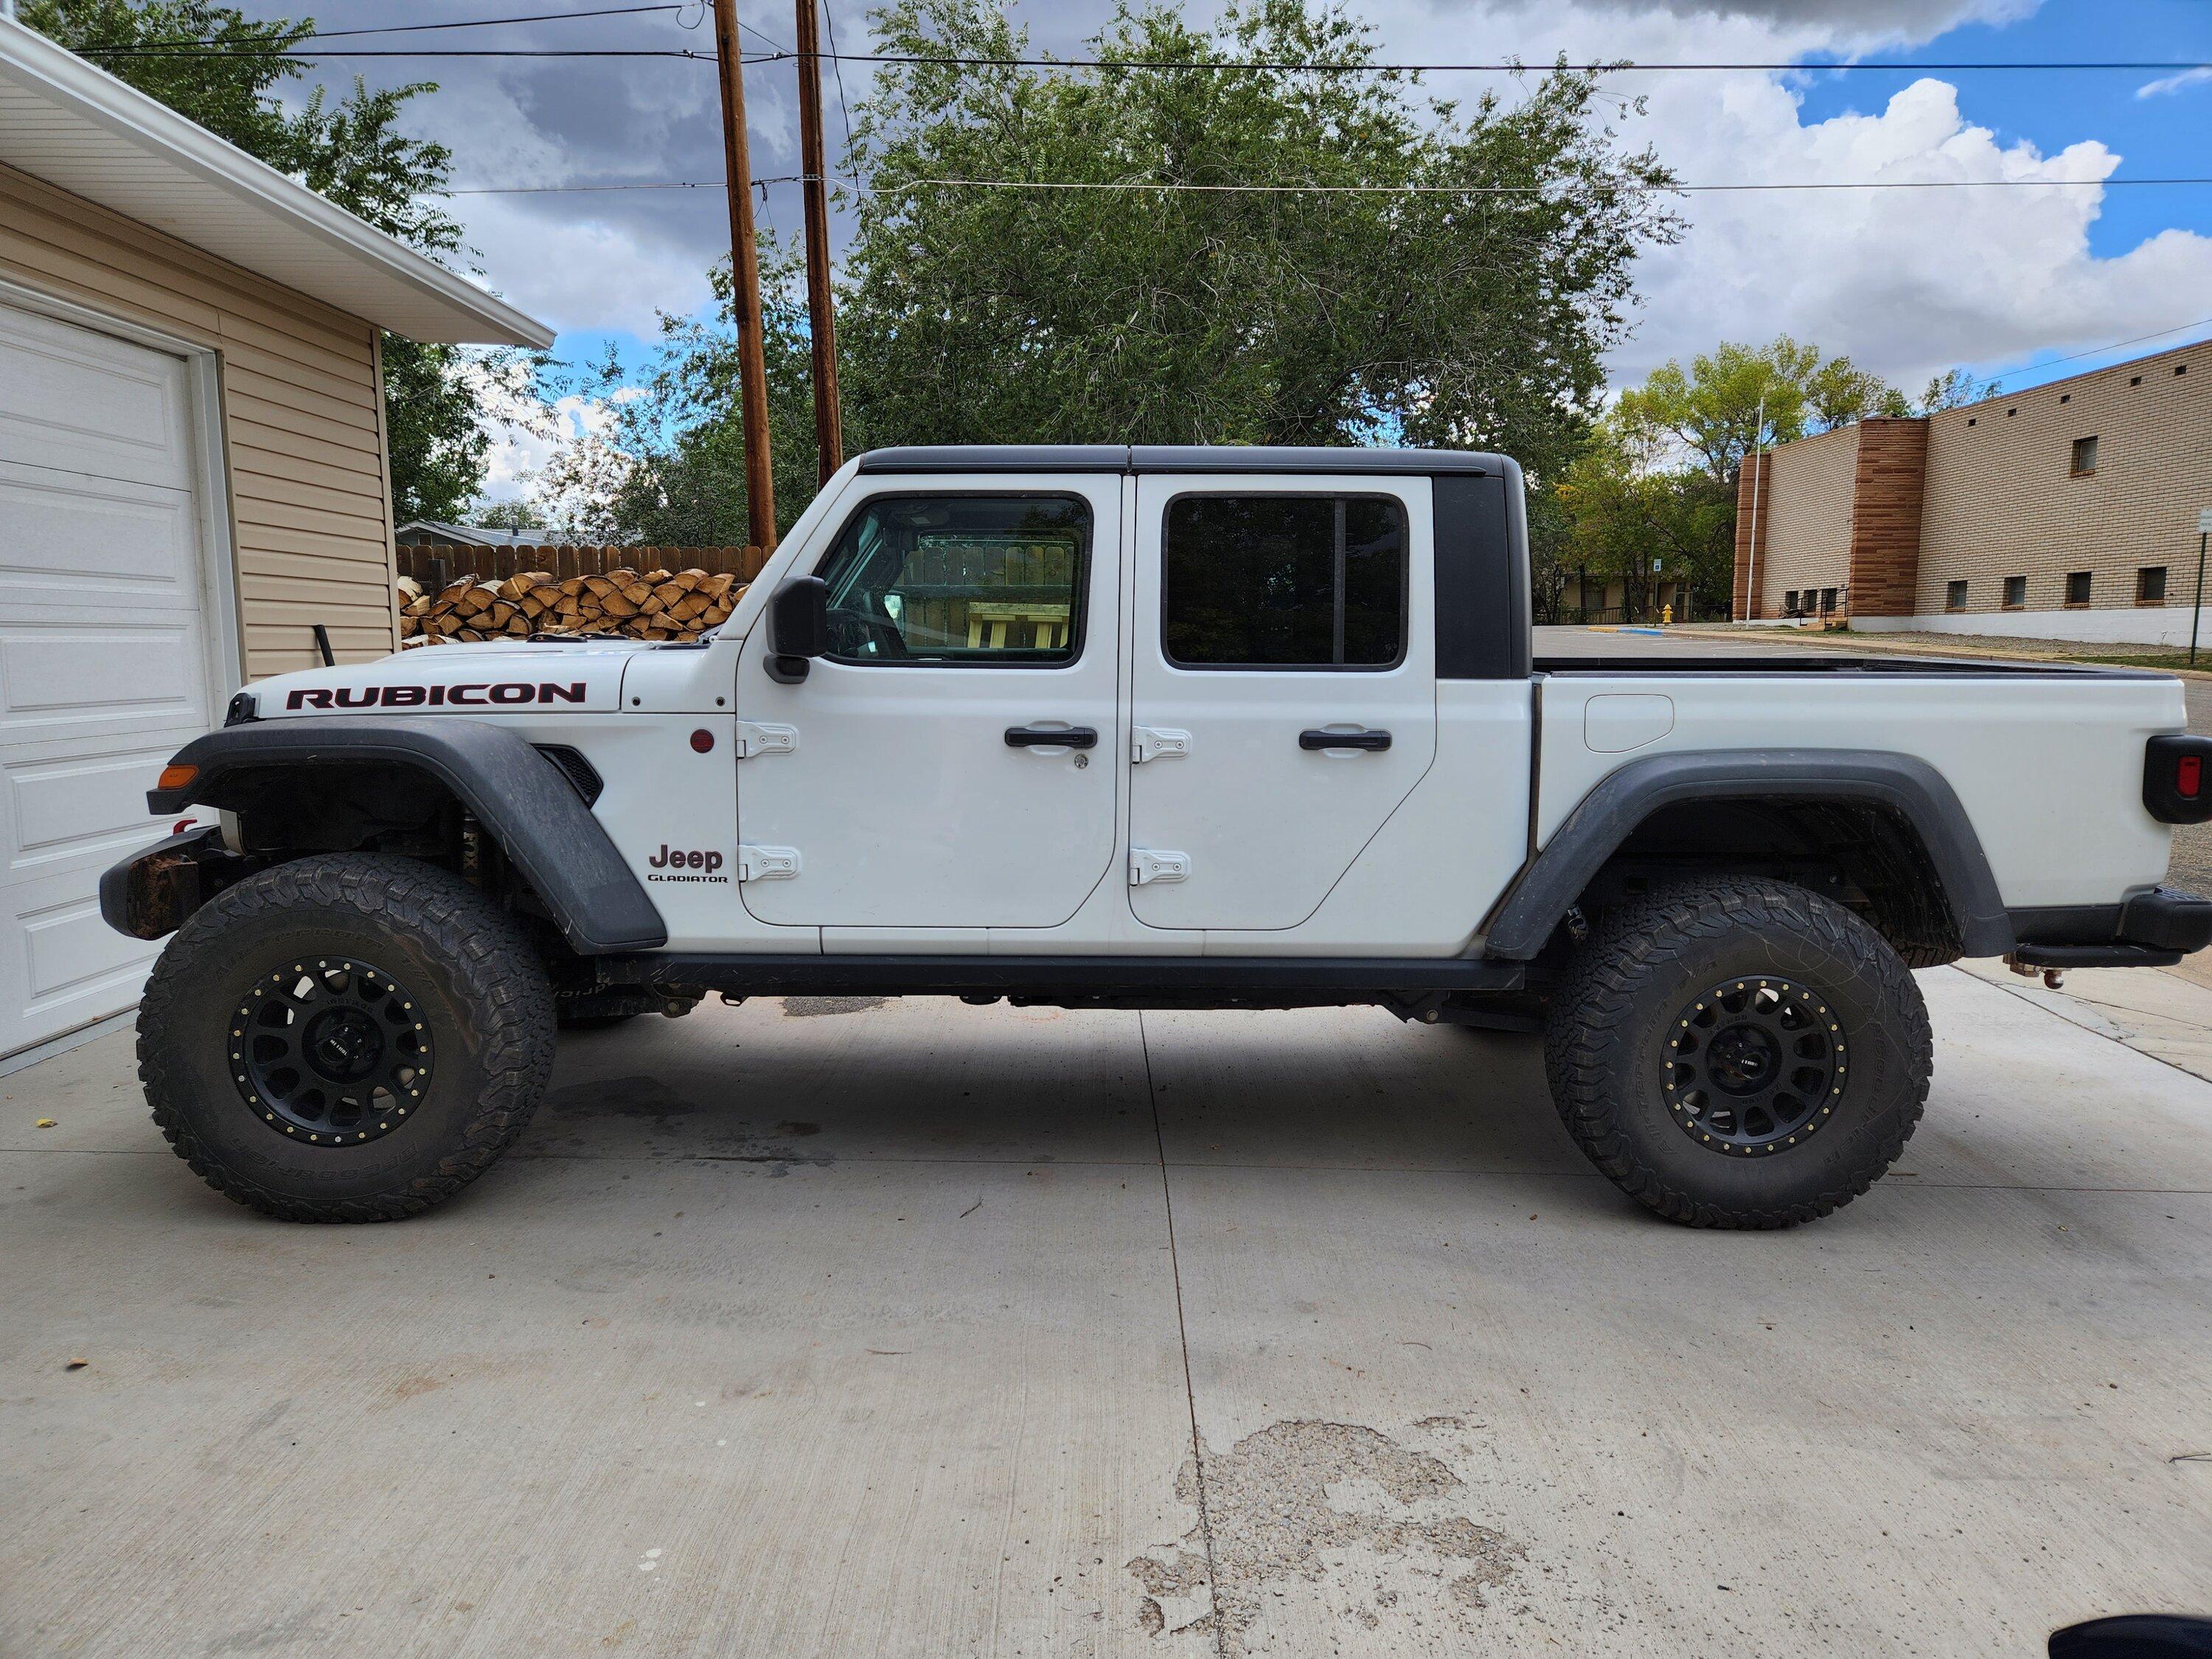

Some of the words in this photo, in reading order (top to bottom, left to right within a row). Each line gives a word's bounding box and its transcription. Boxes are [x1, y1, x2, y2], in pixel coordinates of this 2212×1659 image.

[286, 682, 587, 710] RUBICON
[463, 832, 479, 871] FOX
[649, 844, 723, 874] Jeep
[647, 874, 728, 883] GLADIATOR
